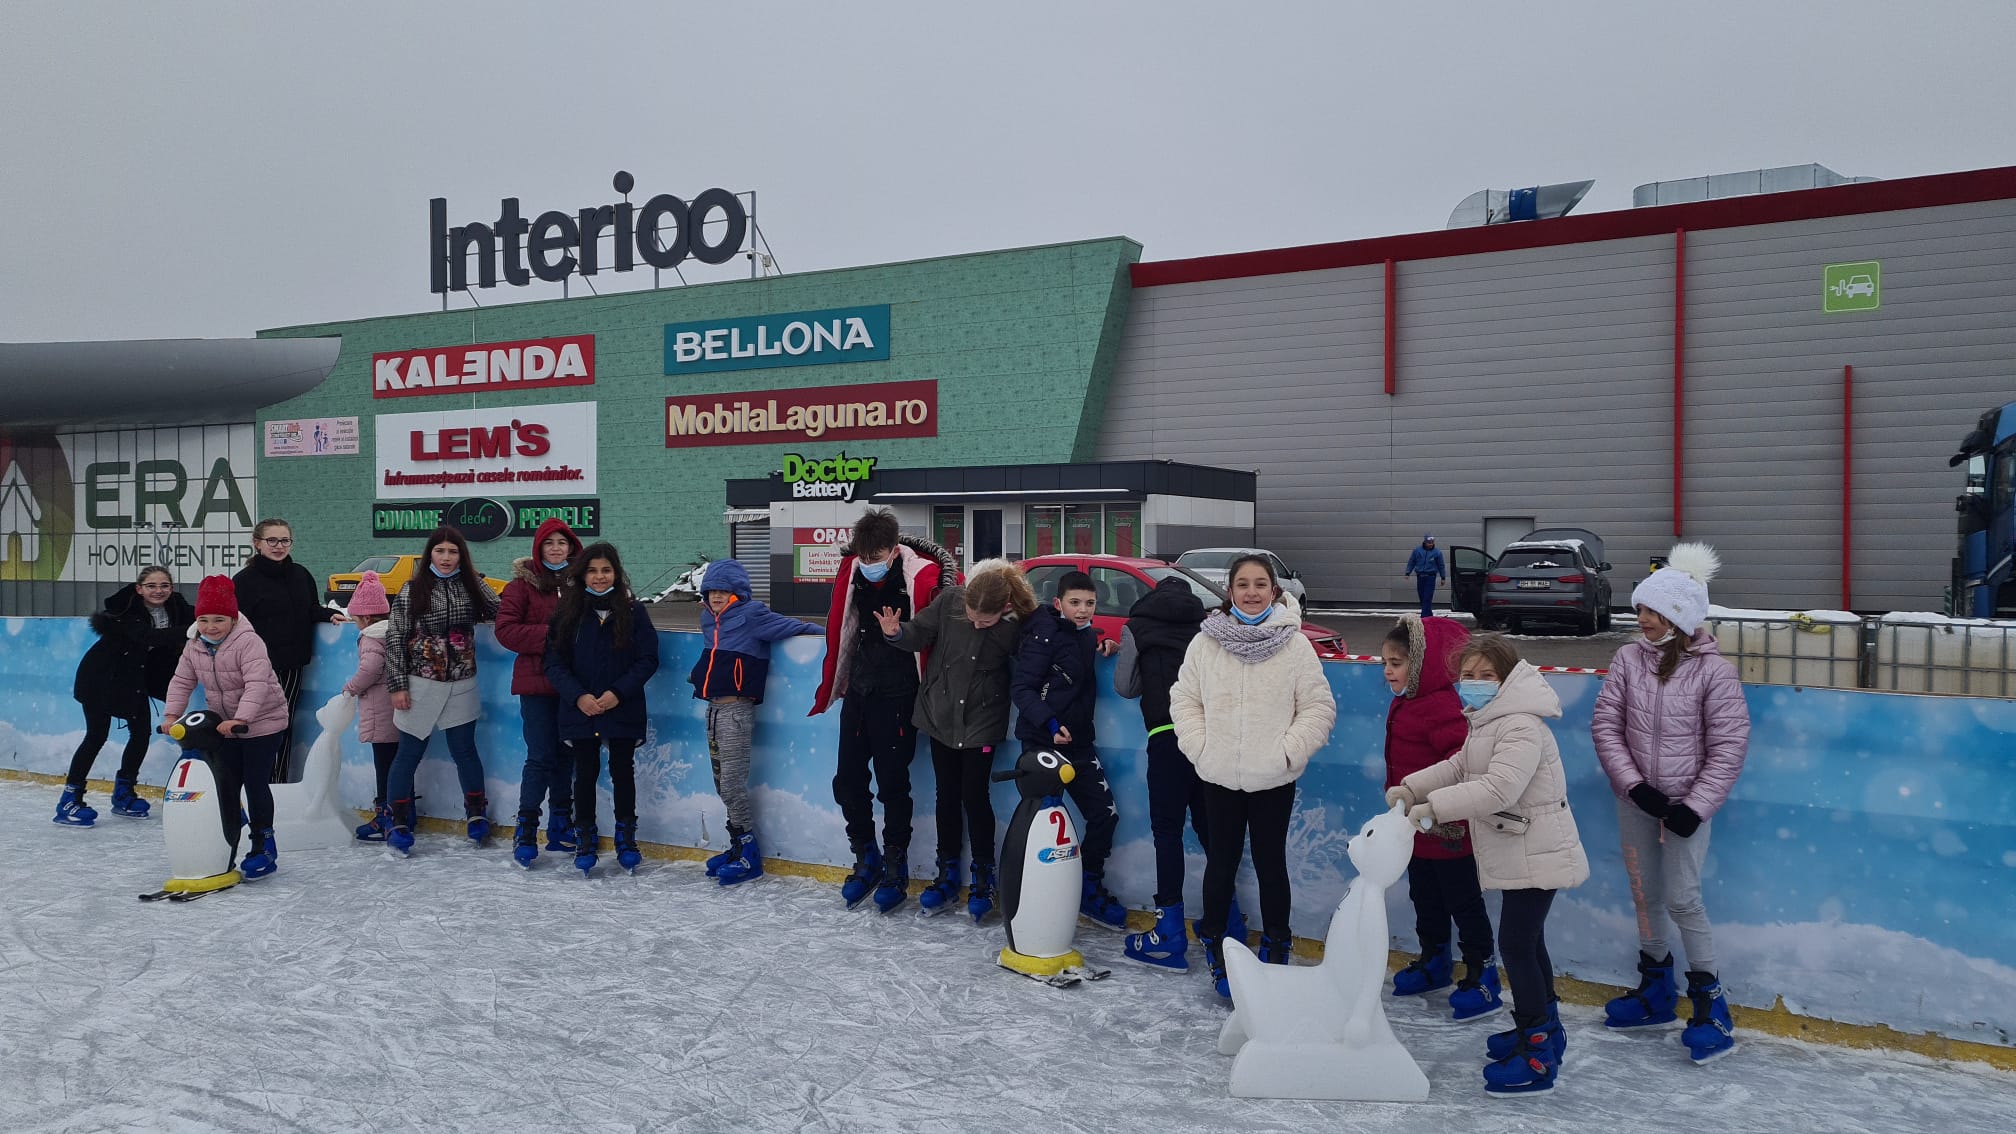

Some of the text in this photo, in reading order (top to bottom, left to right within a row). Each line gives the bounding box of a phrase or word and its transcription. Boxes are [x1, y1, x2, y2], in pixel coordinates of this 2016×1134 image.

[673, 317, 875, 363] BELLONA
[375, 343, 588, 391] KALENDA
[668, 399, 928, 437] MobilaLaguna.ro
[477, 467, 515, 483] casele
[783, 452, 876, 483] Doctor
[85, 457, 254, 529] ERA
[792, 480, 856, 501] Battery
[375, 509, 443, 531] COVOARE
[88, 545, 253, 567] HOME CENTER
[178, 760, 192, 788] 1
[1050, 810, 1071, 846] 2
